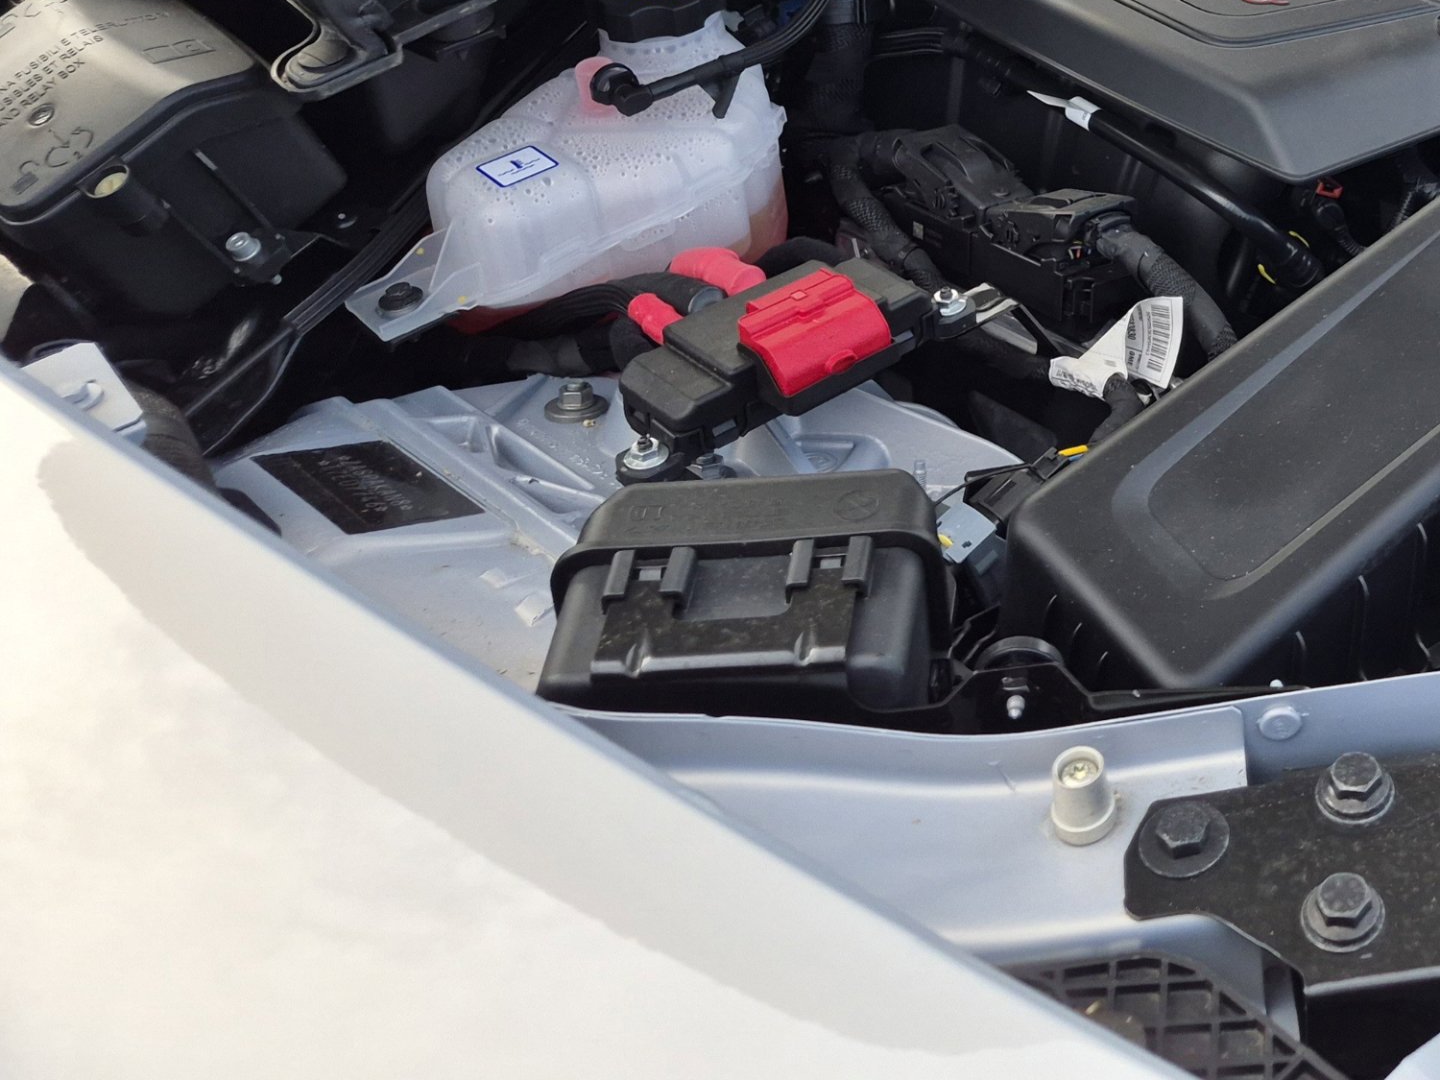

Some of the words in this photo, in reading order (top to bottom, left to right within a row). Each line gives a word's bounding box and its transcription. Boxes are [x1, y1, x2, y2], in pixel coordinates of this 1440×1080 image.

[42, 59, 58, 75] ET
[58, 34, 104, 62] RELAIS
[19, 76, 56, 109] RELAY
[57, 57, 86, 80] BOX
